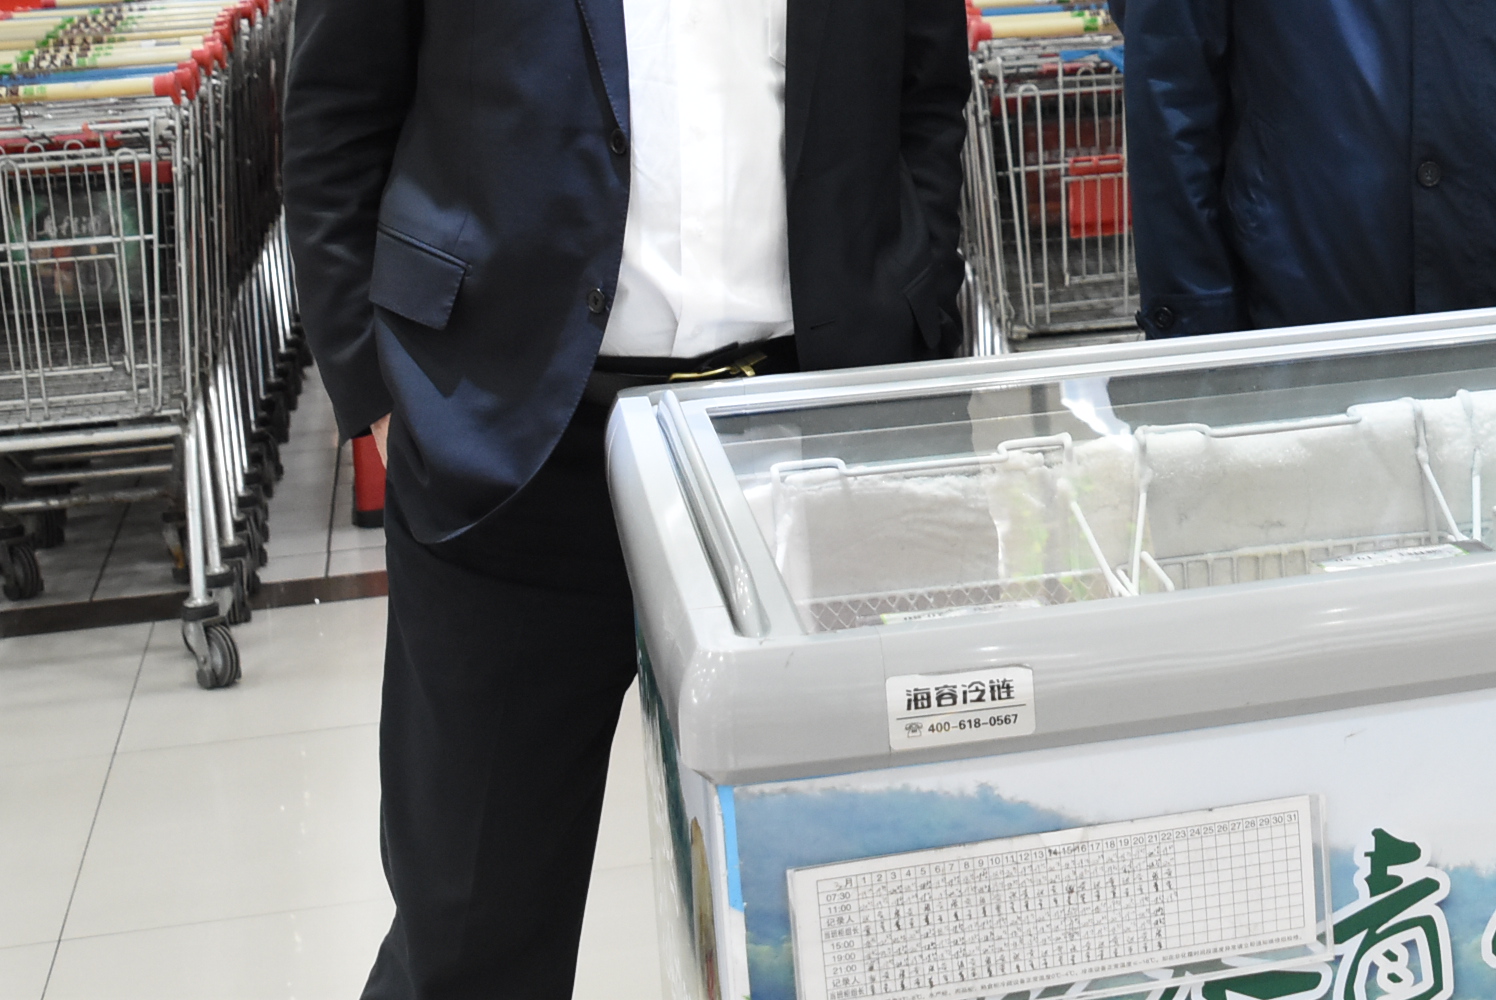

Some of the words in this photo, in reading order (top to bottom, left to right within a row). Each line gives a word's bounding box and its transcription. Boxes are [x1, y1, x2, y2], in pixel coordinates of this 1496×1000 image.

[905, 678, 1016, 711] 海容冷链
[927, 713, 1019, 734] 400-618-0567
[862, 876, 868, 884] 1
[876, 873, 884, 882] 2
[890, 871, 898, 880] 3
[905, 869, 912, 878] 4
[920, 867, 927, 876] 5
[934, 865, 941, 874] 6
[948, 863, 955, 872] 7
[963, 861, 970, 869] 8
[978, 859, 985, 868] 9
[990, 856, 1001, 866] 10
[1004, 855, 1016, 863] 11
[1019, 852, 1030, 861] 12
[1033, 850, 1044, 859] 13
[1062, 846, 1073, 855] 15
[1076, 844, 1087, 853] 16
[1090, 842, 1101, 851] 17
[1104, 840, 1116, 849] 18
[1119, 838, 1130, 847] 19
[1132, 836, 1144, 845] 20
[1147, 834, 1158, 843] 21
[1160, 832, 1172, 841] 22
[1175, 830, 1187, 839] 23
[1189, 828, 1201, 837] 24
[1203, 826, 1214, 835] 25
[1216, 824, 1228, 833] 26
[1230, 822, 1241, 831] 27
[1244, 820, 1256, 828] 28
[1258, 818, 1270, 827] 29
[1272, 815, 1283, 824] 30
[1286, 813, 1297, 823] 31
[826, 892, 851, 902] 07:30
[828, 904, 852, 914] 11:00
[831, 940, 855, 951] 15:00
[832, 952, 856, 962] 19:00
[833, 964, 857, 975] 21:00
